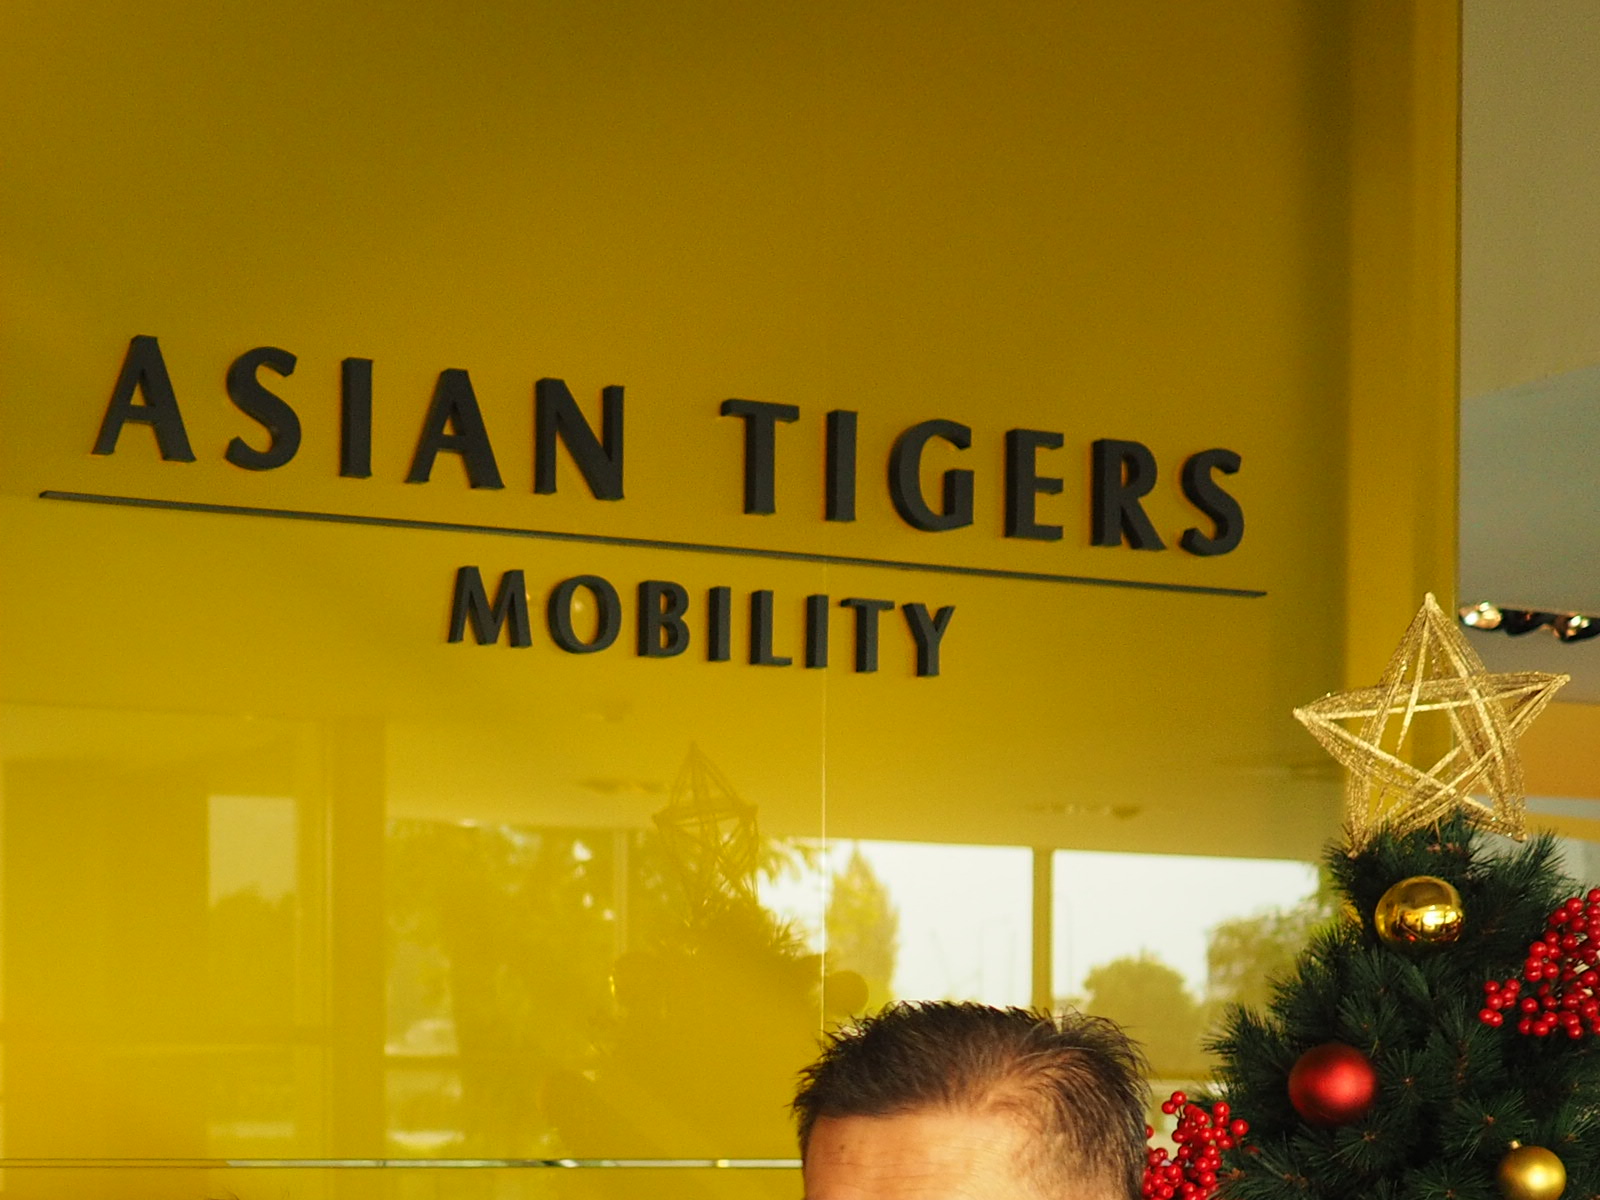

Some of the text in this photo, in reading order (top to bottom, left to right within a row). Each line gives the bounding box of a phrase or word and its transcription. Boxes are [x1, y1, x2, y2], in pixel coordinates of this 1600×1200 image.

[92, 334, 1246, 558] ASIAN TIGERS
[447, 565, 956, 677] MOBILITY
